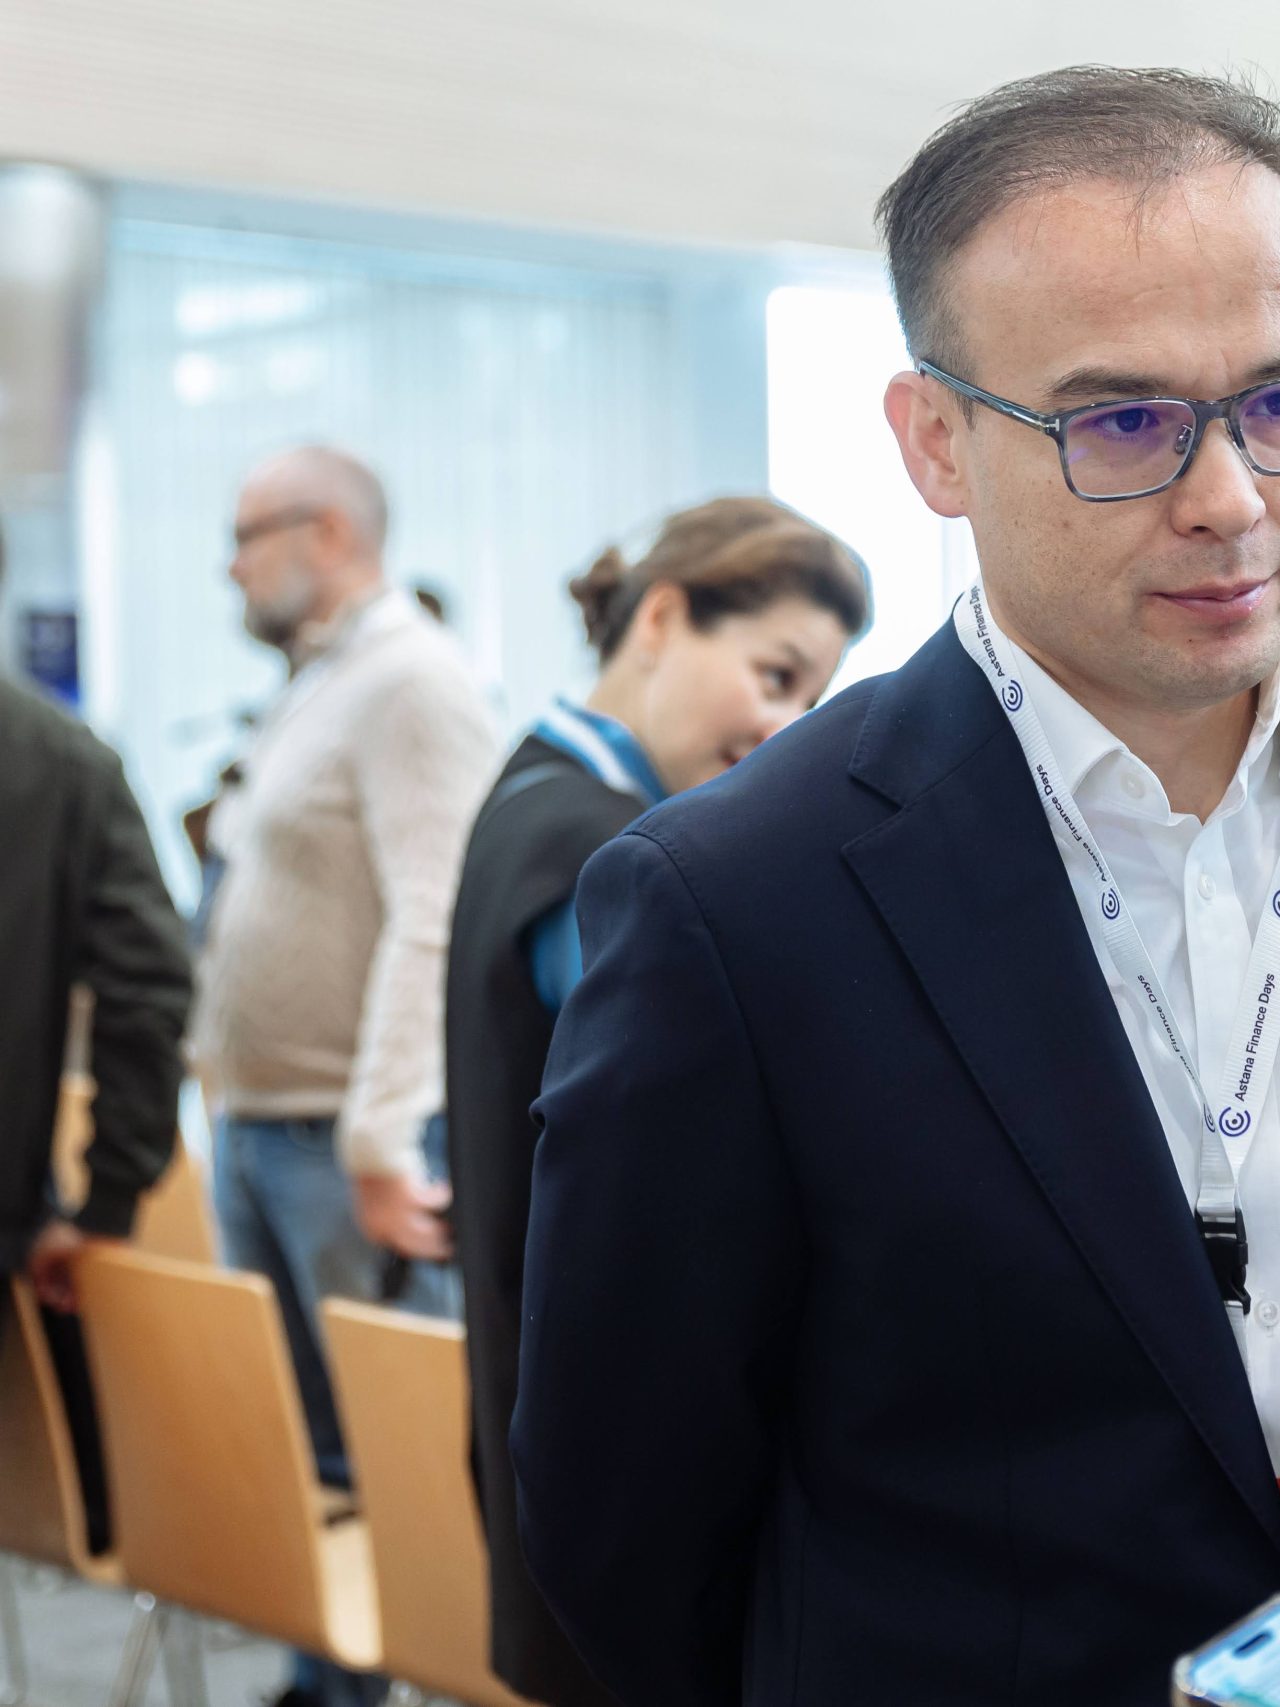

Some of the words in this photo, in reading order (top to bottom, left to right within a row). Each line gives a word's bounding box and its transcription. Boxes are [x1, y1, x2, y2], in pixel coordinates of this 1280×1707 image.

[974, 604, 988, 638] Finance
[983, 638, 1005, 677] Astana
[1036, 764, 1053, 796] Days
[1052, 796, 1082, 842] Finance
[1083, 842, 1107, 882] Astana
[1137, 974, 1157, 1003] Days
[1157, 1006, 1180, 1053] Finance
[1235, 1057, 1255, 1102] Astana
[1246, 1006, 1267, 1054] Finance
[1258, 973, 1275, 1004] Days
